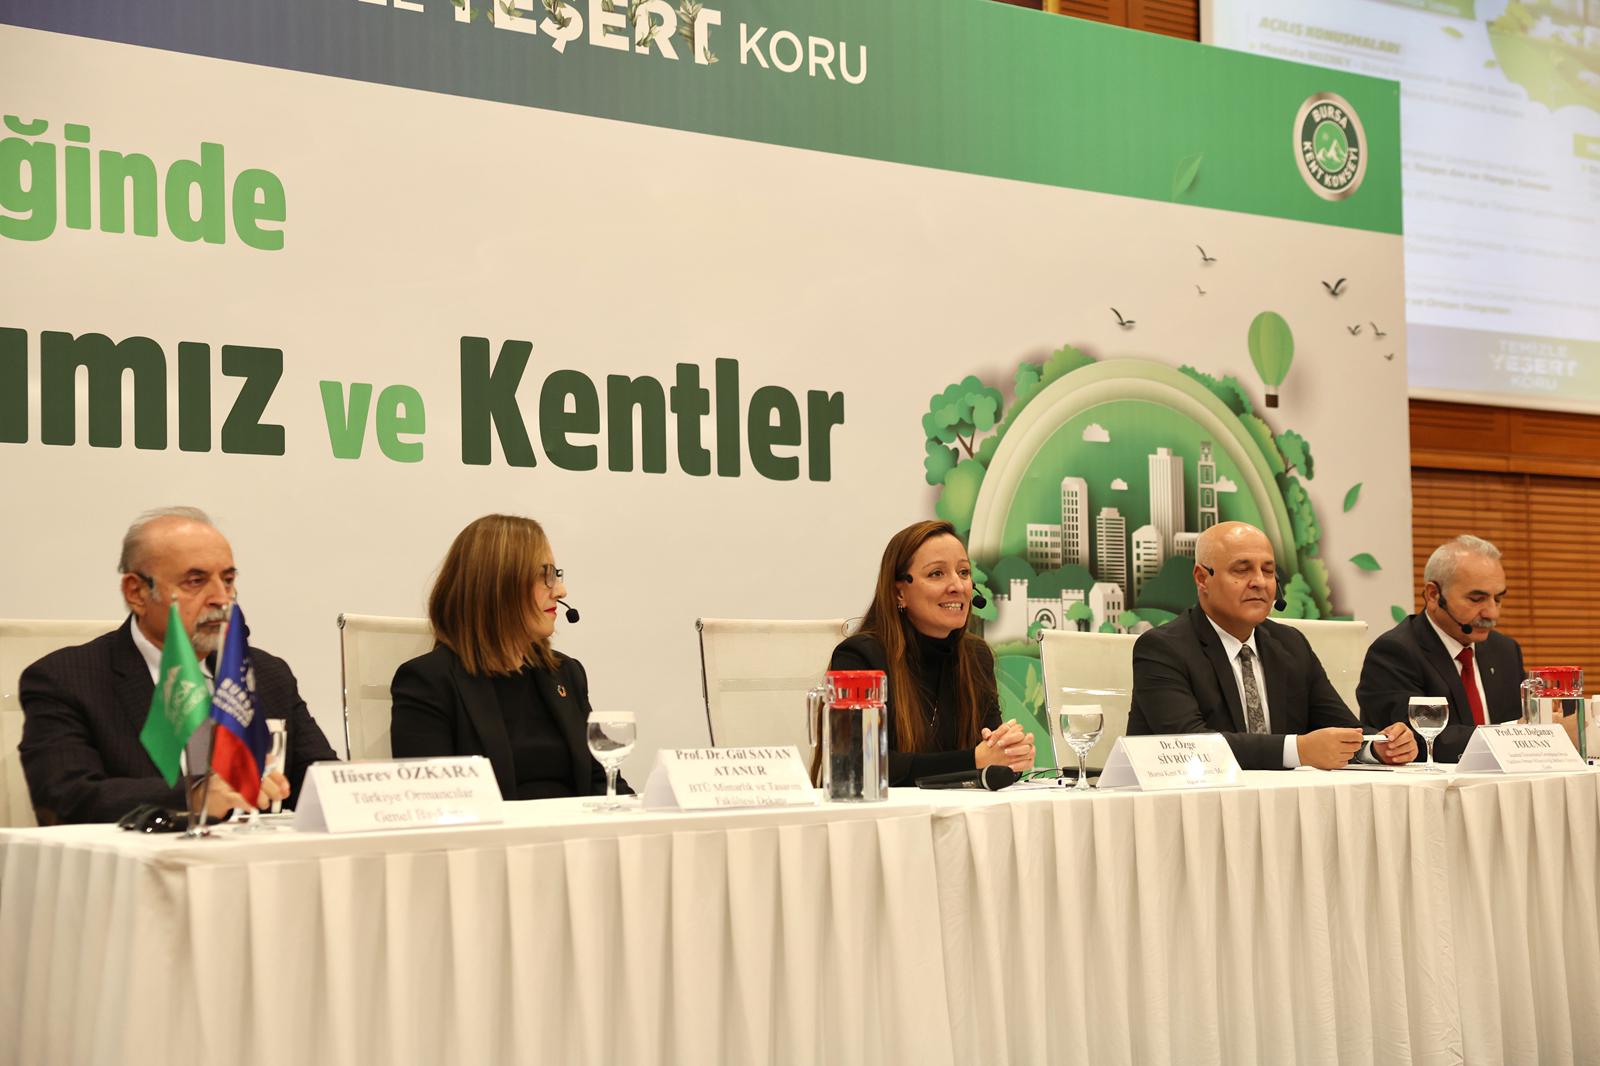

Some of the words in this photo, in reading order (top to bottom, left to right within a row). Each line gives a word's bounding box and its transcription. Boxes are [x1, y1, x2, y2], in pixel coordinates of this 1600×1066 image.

[738, 22, 868, 85] KORU
[1311, 105, 1348, 129] BURSA
[1303, 141, 1325, 180] KENT
[0, 115, 287, 251] ğinde
[320, 381, 426, 463] ve
[460, 336, 845, 483] Kentler
[1494, 727, 1514, 737] Prof.
[1514, 727, 1525, 736] Dr.
[1159, 740, 1176, 750] Dr.
[1176, 738, 1197, 750] Özge
[1513, 740, 1551, 749] TOLUNAY
[675, 749, 704, 761] Prof.
[706, 749, 725, 760] Dr.
[726, 748, 747, 760] Gül
[749, 747, 792, 759] SAYAN
[1157, 752, 1212, 765] SİVRİOLU
[331, 769, 392, 785] Hüsrev
[397, 763, 479, 781] ÖZKARA
[713, 765, 768, 777] ATANUR
[351, 791, 402, 807] Türkiye
[374, 808, 413, 823] Genel
